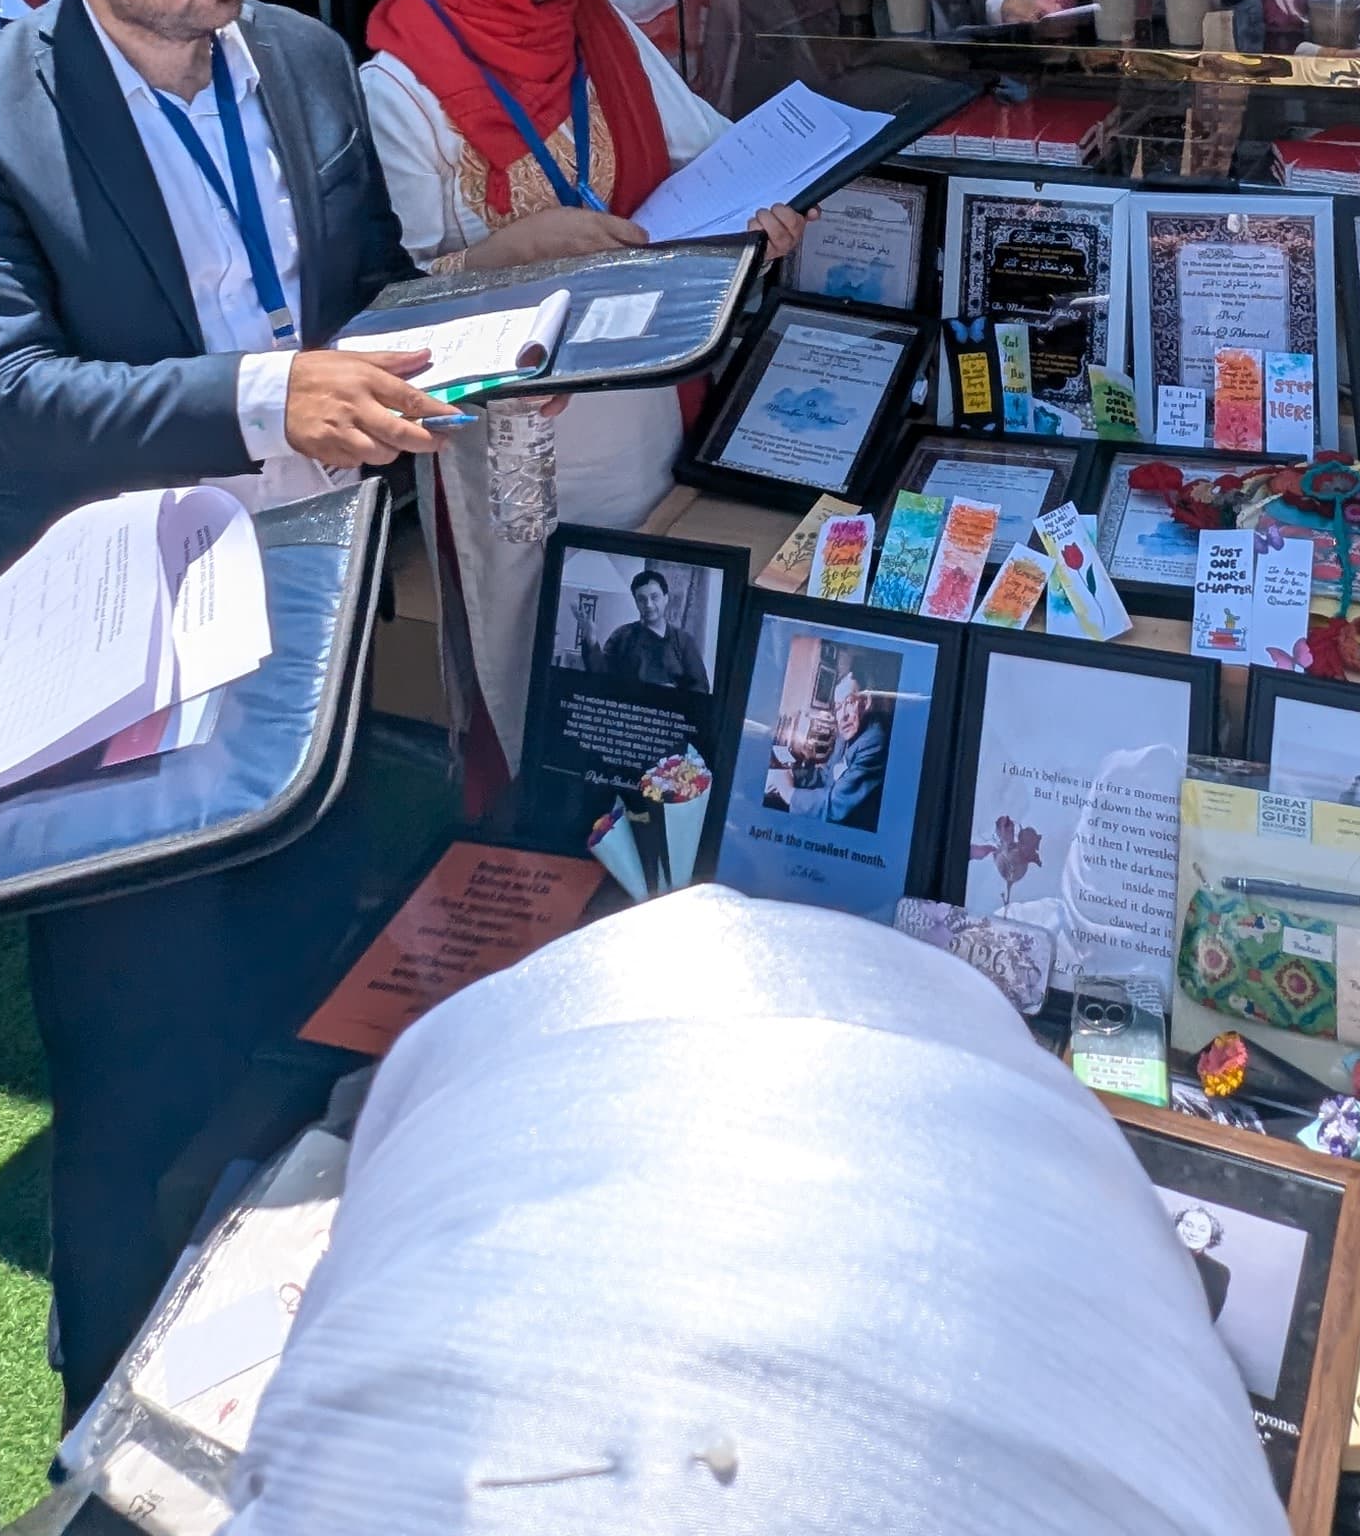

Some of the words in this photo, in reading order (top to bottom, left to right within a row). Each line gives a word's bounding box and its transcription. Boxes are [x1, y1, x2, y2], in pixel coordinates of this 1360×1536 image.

[1103, 386, 1133, 402] JUST
[1274, 378, 1313, 396] STOP
[1106, 398, 1126, 407] ONE
[1269, 401, 1313, 422] HERE
[1209, 545, 1243, 558] JUST
[1210, 559, 1237, 569] ONE
[1207, 570, 1246, 581] MORE
[1196, 582, 1252, 595] CHAPTER
[1009, 765, 1040, 779] didn't
[1042, 770, 1079, 786] believe
[1082, 779, 1093, 789] in
[1095, 780, 1103, 791] it
[1106, 783, 1125, 795] for
[1034, 787, 1053, 801] But
[1062, 794, 1098, 810] gulped
[1100, 799, 1132, 815] down
[1134, 806, 1152, 819] the
[1262, 795, 1307, 810] GREAT
[1262, 811, 1307, 827] GIFTS
[1088, 816, 1099, 827] of
[1101, 821, 1119, 834] my
[1121, 825, 1146, 837] own
[1149, 829, 1178, 842] voice
[749, 825, 772, 840] April
[774, 833, 784, 842] is
[786, 834, 802, 847] the
[851, 851, 887, 869] month.
[1073, 833, 1095, 846] And
[1098, 835, 1123, 852] then
[1083, 853, 1107, 867] with
[1110, 857, 1128, 871] the
[1121, 881, 1155, 896] inside
[1079, 888, 1128, 910] Knocked
[1130, 903, 1139, 913] it
[1109, 916, 1148, 933] clawed
[1150, 926, 1161, 937] at
[1070, 928, 1107, 945] ripped
[1109, 936, 1117, 947] it
[1120, 939, 1133, 950] to
[1251, 1409, 1301, 1437] ryone,
